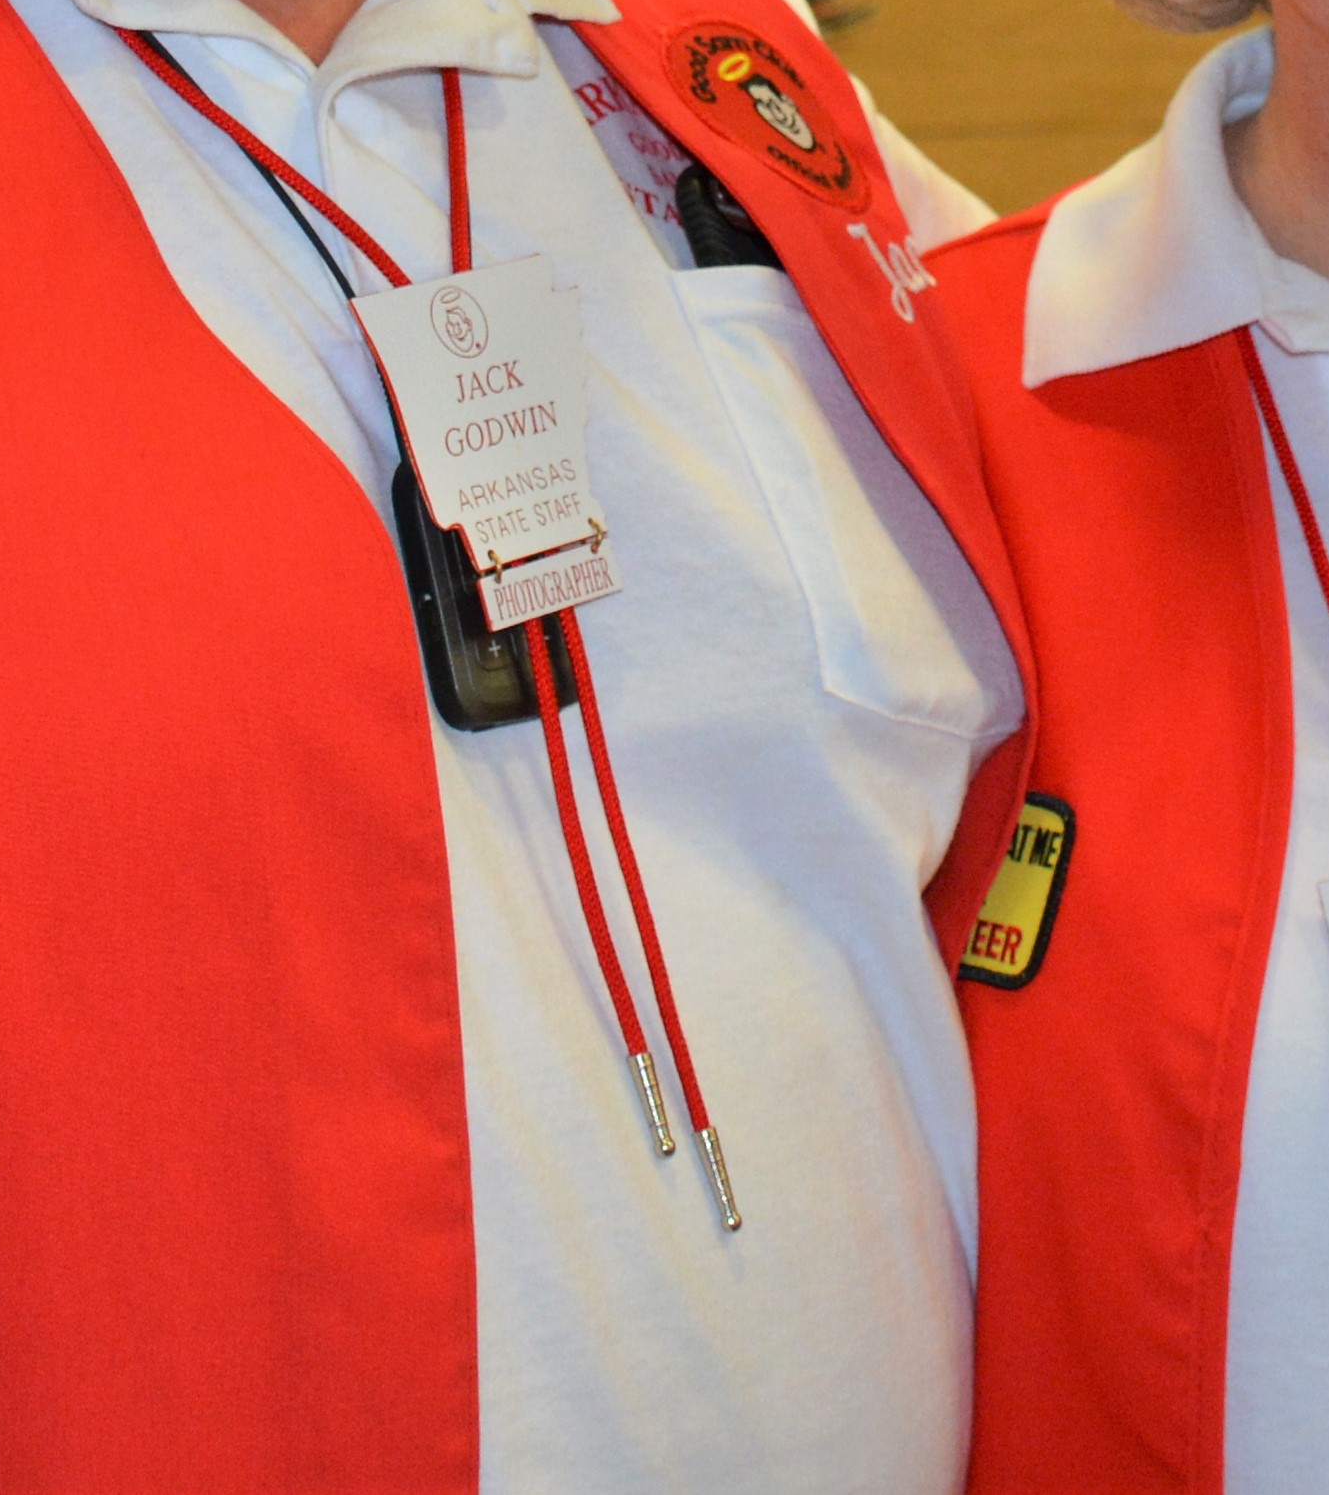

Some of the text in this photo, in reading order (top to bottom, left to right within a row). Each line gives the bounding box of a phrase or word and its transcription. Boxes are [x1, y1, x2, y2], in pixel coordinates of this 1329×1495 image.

[455, 361, 524, 404] JACK
[445, 401, 558, 457] GODWIN
[458, 458, 577, 512] ARKANSAS
[475, 492, 582, 545] STATE STAFF
[494, 557, 614, 621] PHOTOGRAPHER
[1029, 827, 1064, 869] ME
